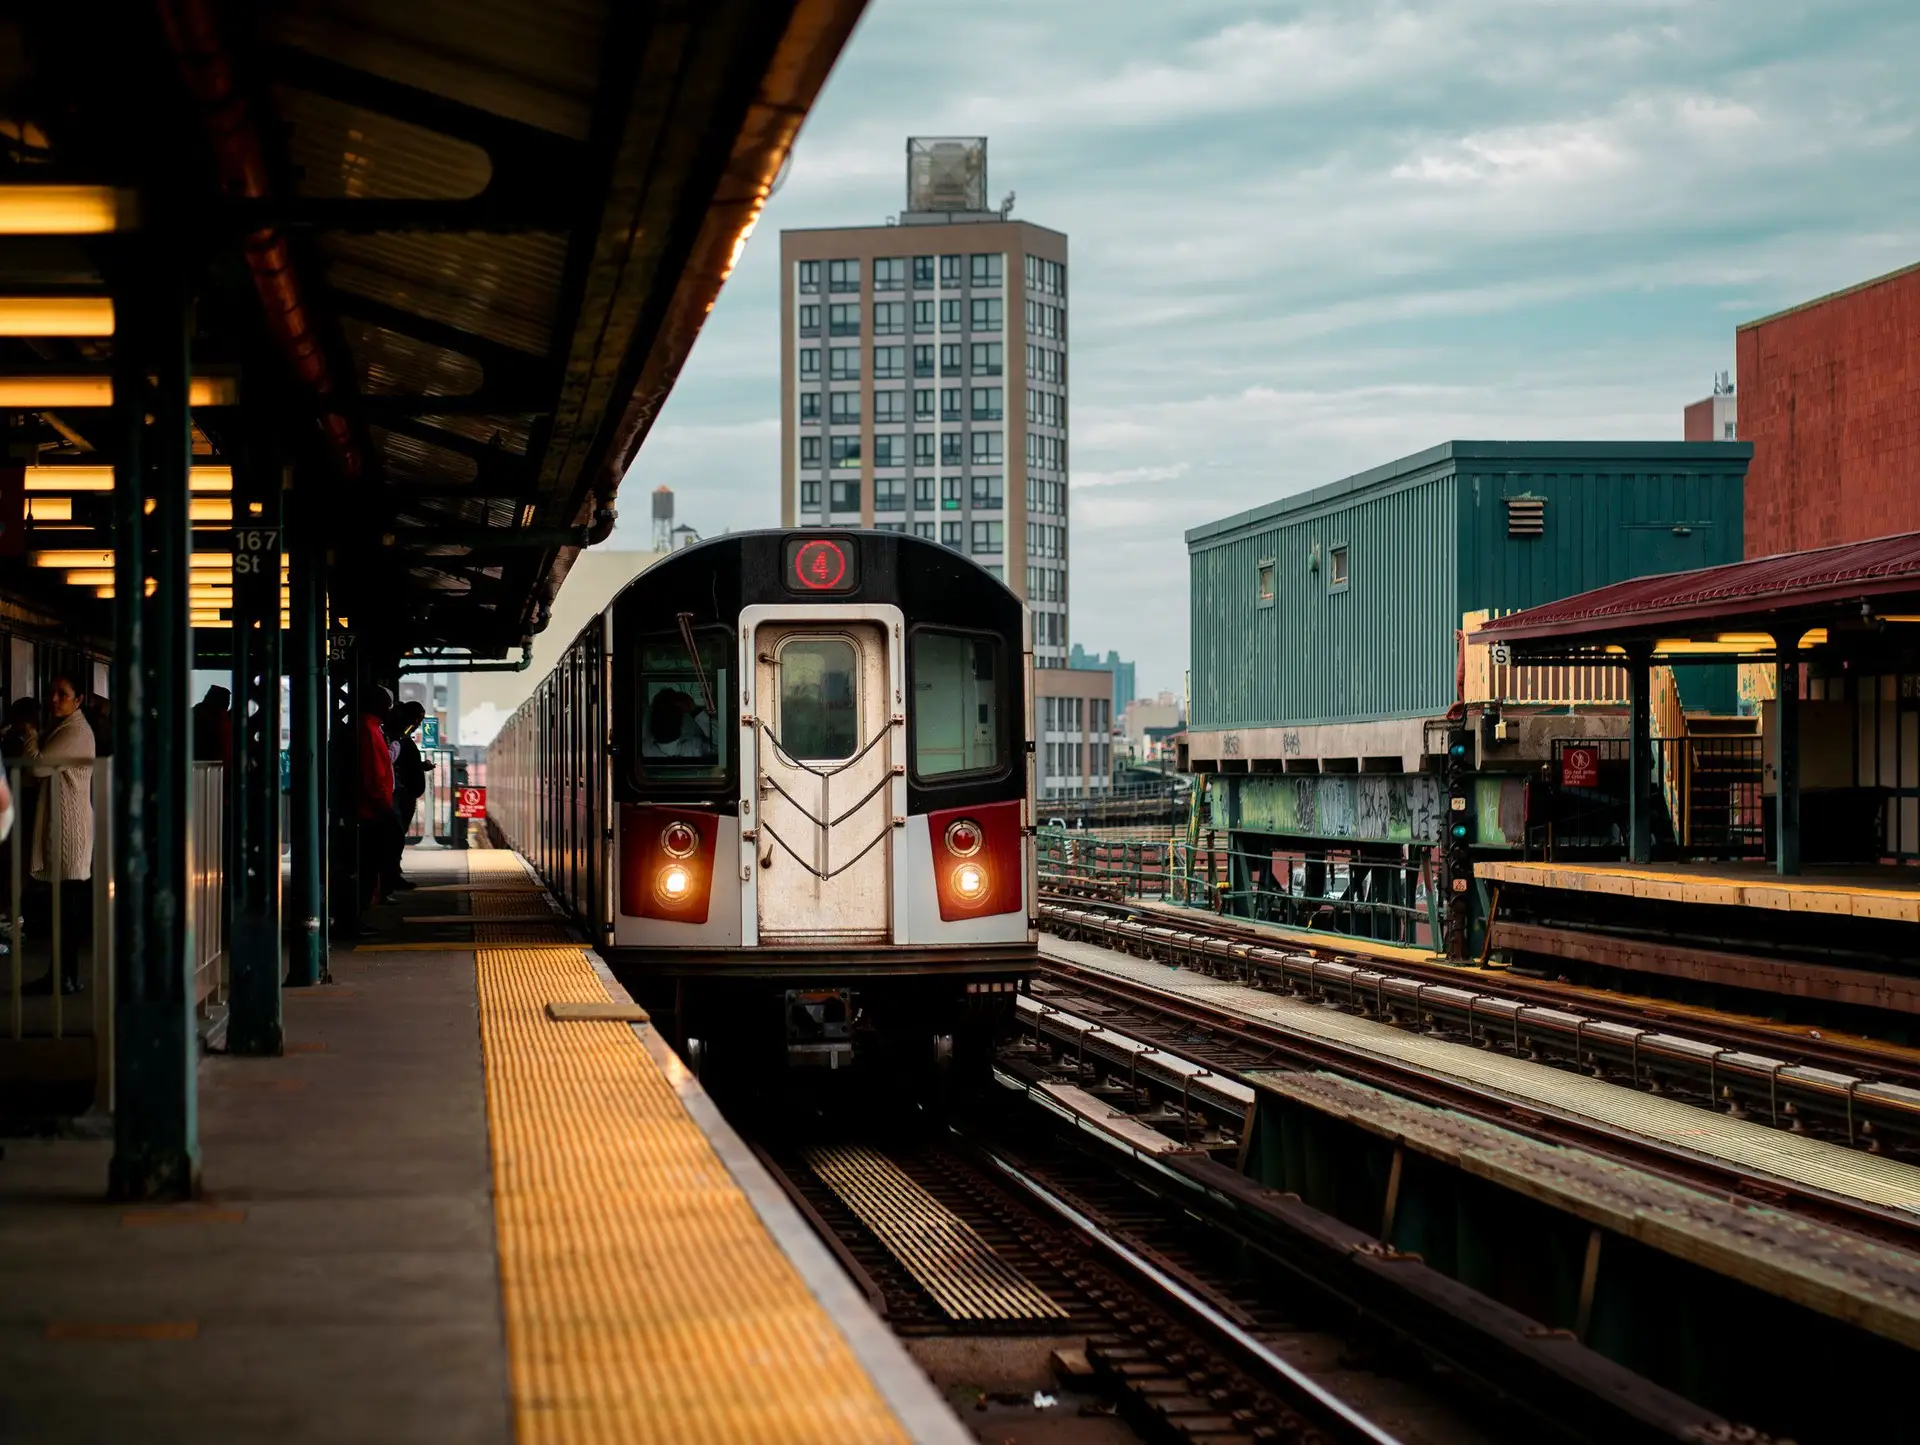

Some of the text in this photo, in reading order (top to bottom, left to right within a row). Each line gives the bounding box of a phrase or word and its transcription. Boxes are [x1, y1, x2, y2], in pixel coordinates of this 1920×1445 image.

[235, 531, 277, 550] 167
[235, 554, 260, 574] St
[812, 551, 828, 579] 4
[331, 635, 355, 647] 167
[331, 648, 345, 660] St
[1495, 649, 1506, 663] S
